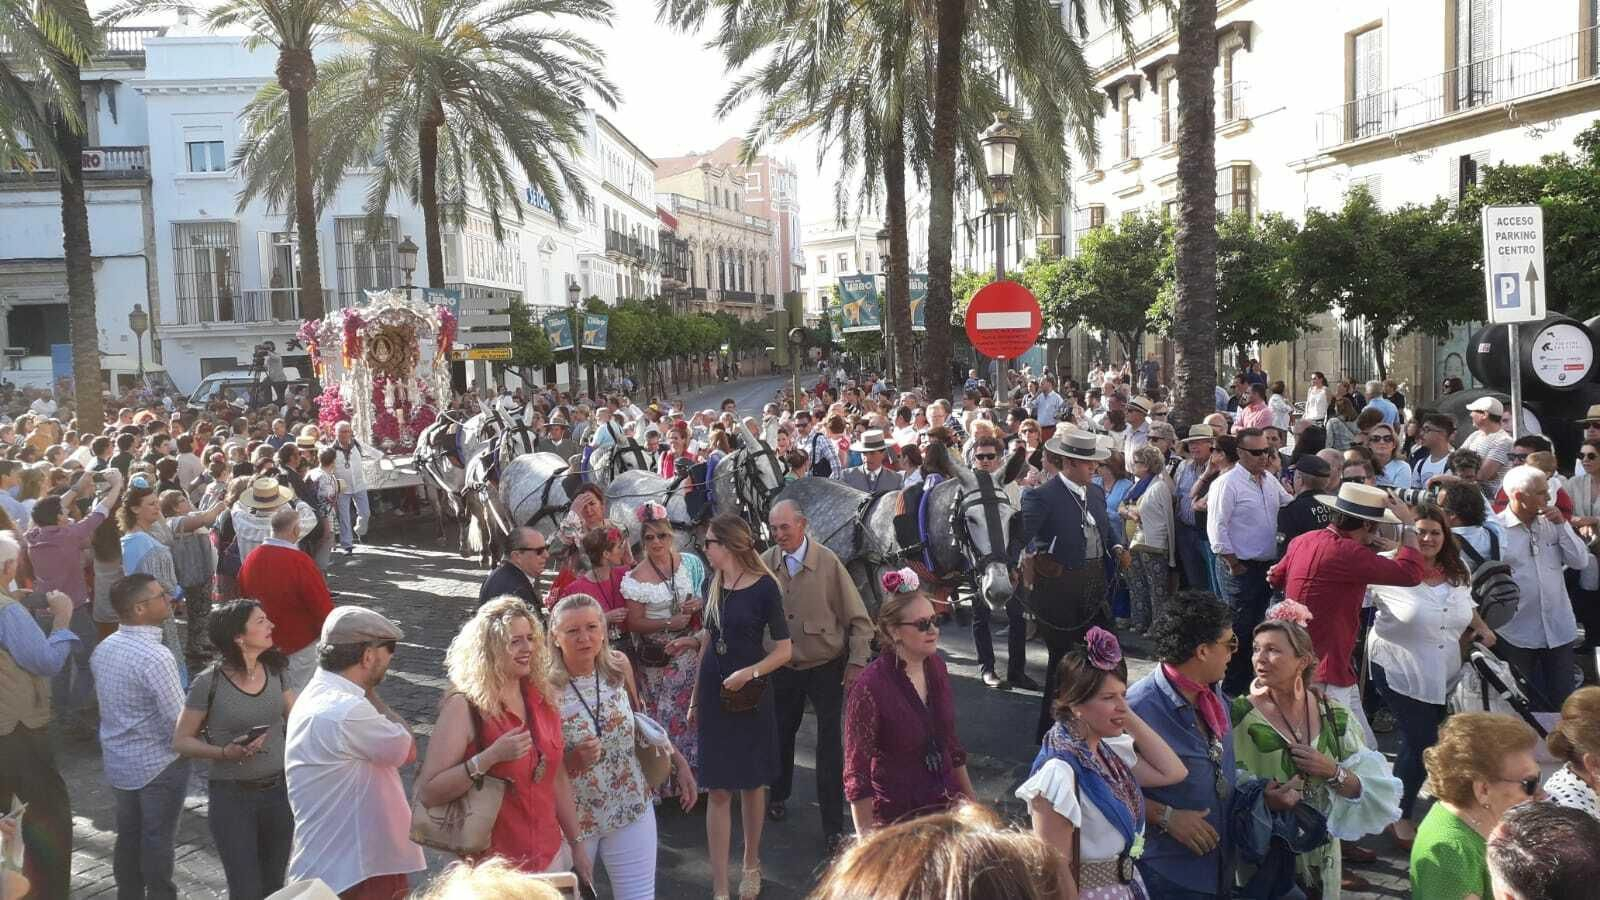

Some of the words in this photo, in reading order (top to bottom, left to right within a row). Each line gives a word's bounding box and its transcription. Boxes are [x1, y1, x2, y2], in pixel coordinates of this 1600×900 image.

[1496, 216, 1534, 226] ACCESO
[1495, 231, 1537, 240] PARKING
[1498, 245, 1536, 255] CENTRO
[1500, 276, 1515, 305] P
